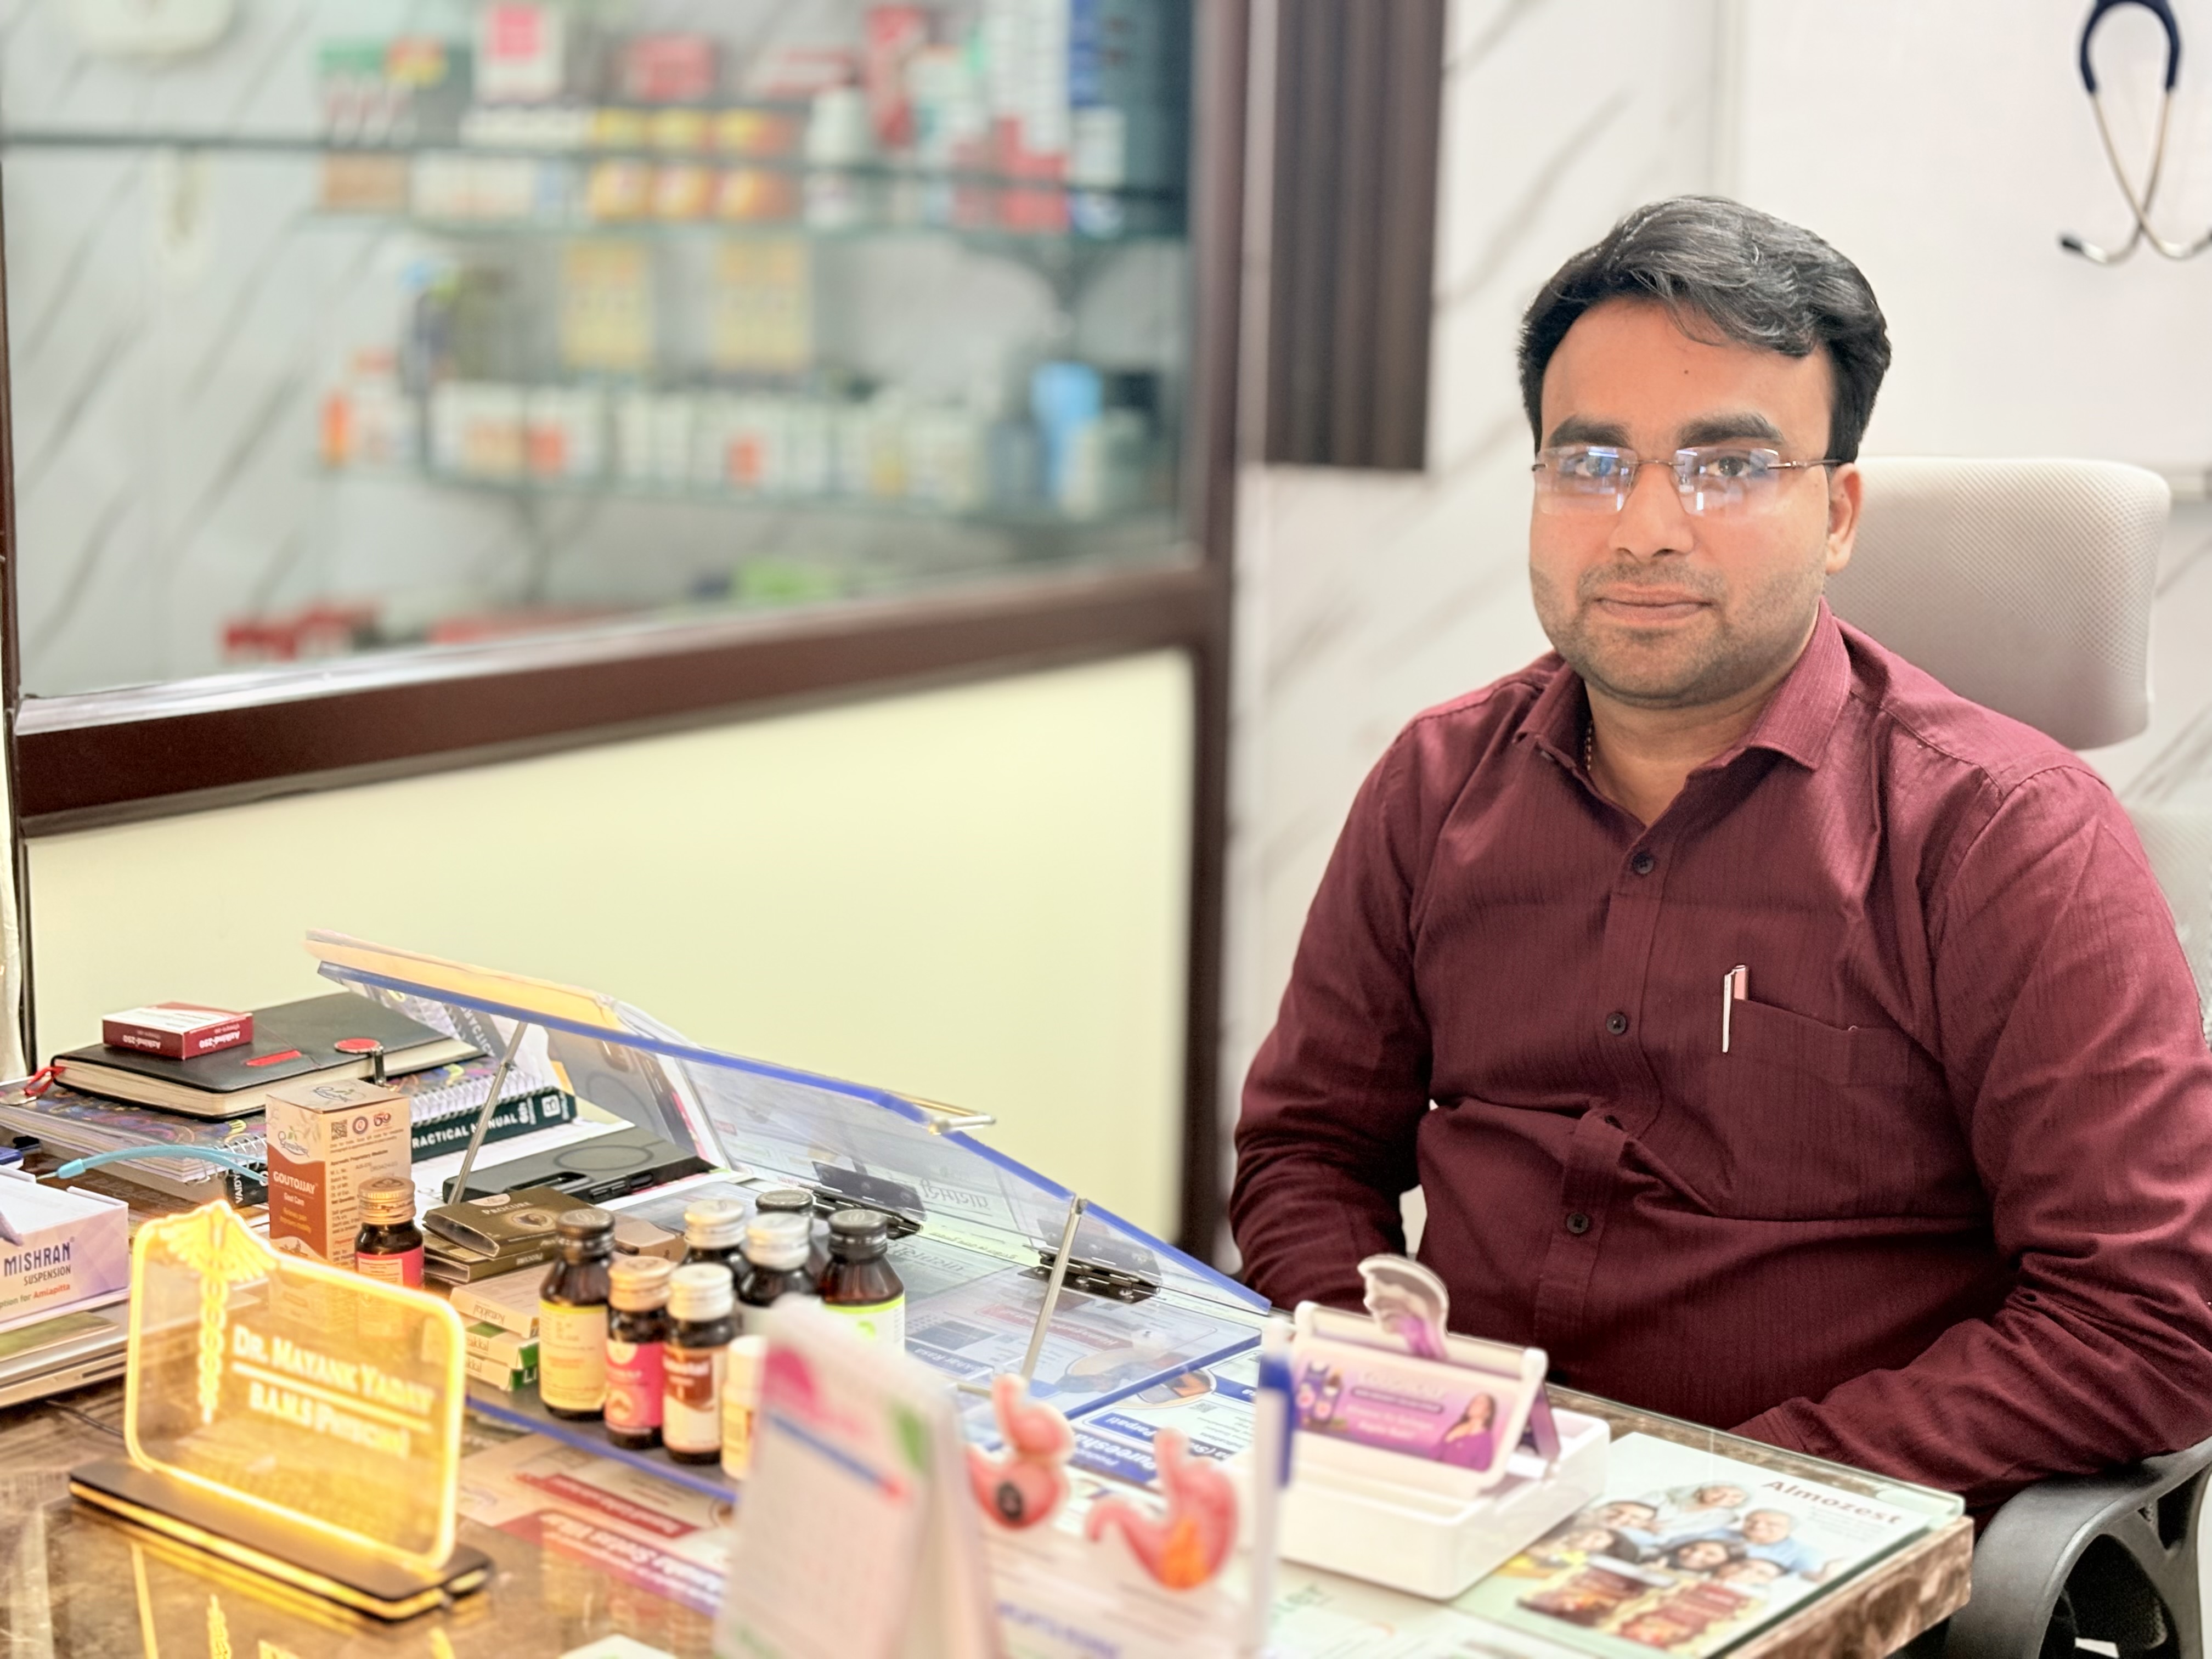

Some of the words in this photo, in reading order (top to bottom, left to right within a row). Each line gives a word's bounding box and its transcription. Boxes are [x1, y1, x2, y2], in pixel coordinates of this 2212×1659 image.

[411, 1125, 470, 1149] RACTICAL
[470, 1113, 518, 1134] MNUAL
[234, 1175, 243, 1204] VAIDY
[4, 1242, 70, 1277] MISHRAN
[24, 1264, 71, 1286] SUSPENSION
[1106, 1417, 1158, 1437] Parpati
[1075, 1433, 1157, 1470] Pureesha
[1761, 1481, 1901, 1525] Almozest
